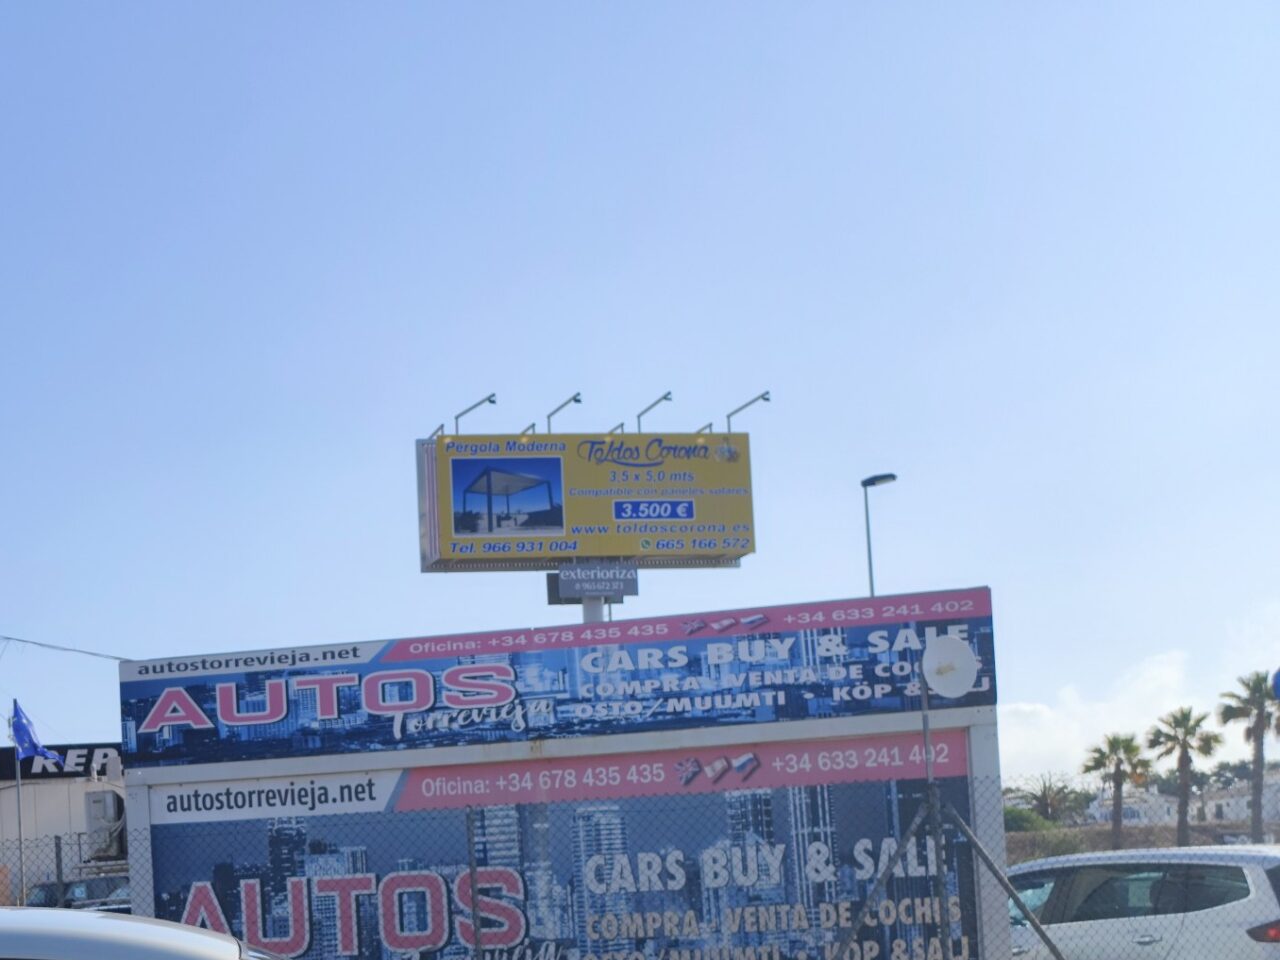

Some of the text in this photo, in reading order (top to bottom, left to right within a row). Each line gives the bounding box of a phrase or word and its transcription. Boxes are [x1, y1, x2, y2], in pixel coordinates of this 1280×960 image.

[446, 440, 566, 455] Pergola Moderna
[577, 438, 709, 464] Toldos Corona
[670, 470, 695, 482] mts
[569, 487, 749, 498] Compatible con paneles solares
[621, 502, 689, 518] 3.500 €
[482, 541, 511, 553] 966
[516, 541, 543, 552] 931
[549, 540, 577, 552] 004
[656, 537, 749, 550] 665 166 572
[784, 600, 974, 624] +34 633 241 402
[409, 623, 668, 654] Oficina: +34 678 435 435
[138, 646, 361, 675] autostorrevieja.net
[580, 645, 689, 673] CARS
[707, 636, 795, 665] BUY
[816, 634, 849, 657] &
[580, 676, 701, 697] COMPRA
[727, 668, 817, 689] VENTA
[829, 664, 864, 680] DE
[832, 681, 892, 701] KÖP
[137, 663, 516, 733] AUTOS
[386, 700, 552, 740] Torrevieja
[772, 753, 811, 773] +34
[818, 750, 858, 771] 633
[864, 747, 903, 767] 241
[422, 763, 665, 796] Oficina: +34 678 435 435
[166, 778, 376, 813] autostorrevieja.net
[585, 849, 687, 894] CARS
[701, 843, 786, 888] BUY
[805, 840, 838, 883] &
[181, 866, 526, 957] AUTOS
[586, 909, 700, 941] COMPRA
[726, 903, 810, 933] VENTA
[819, 901, 853, 928] DE
